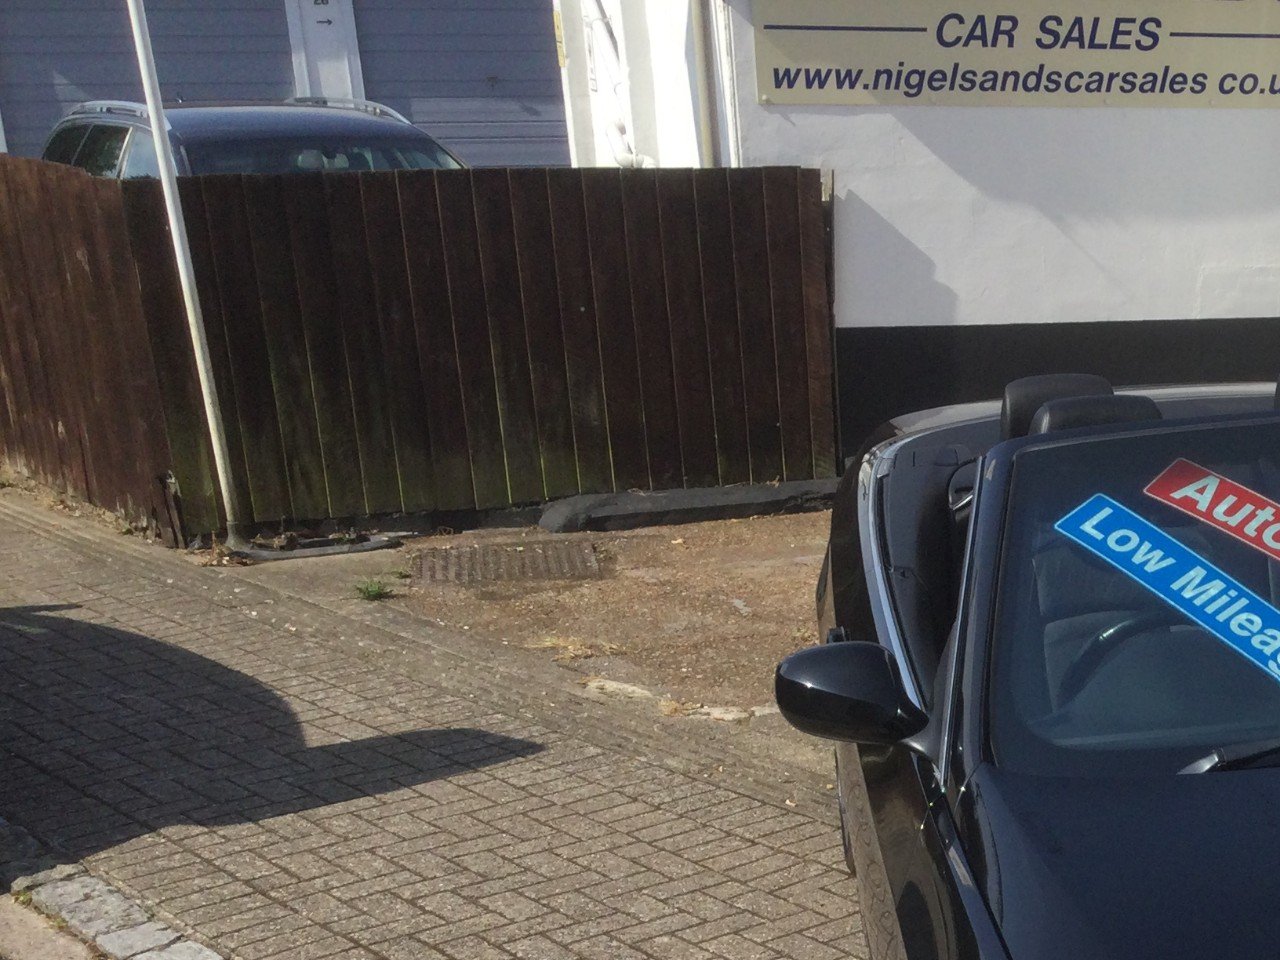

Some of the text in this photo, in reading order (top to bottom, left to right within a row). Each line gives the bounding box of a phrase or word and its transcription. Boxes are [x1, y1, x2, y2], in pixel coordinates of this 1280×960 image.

[936, 13, 1164, 51] CAR SALES
[1078, 506, 1176, 574] Low
